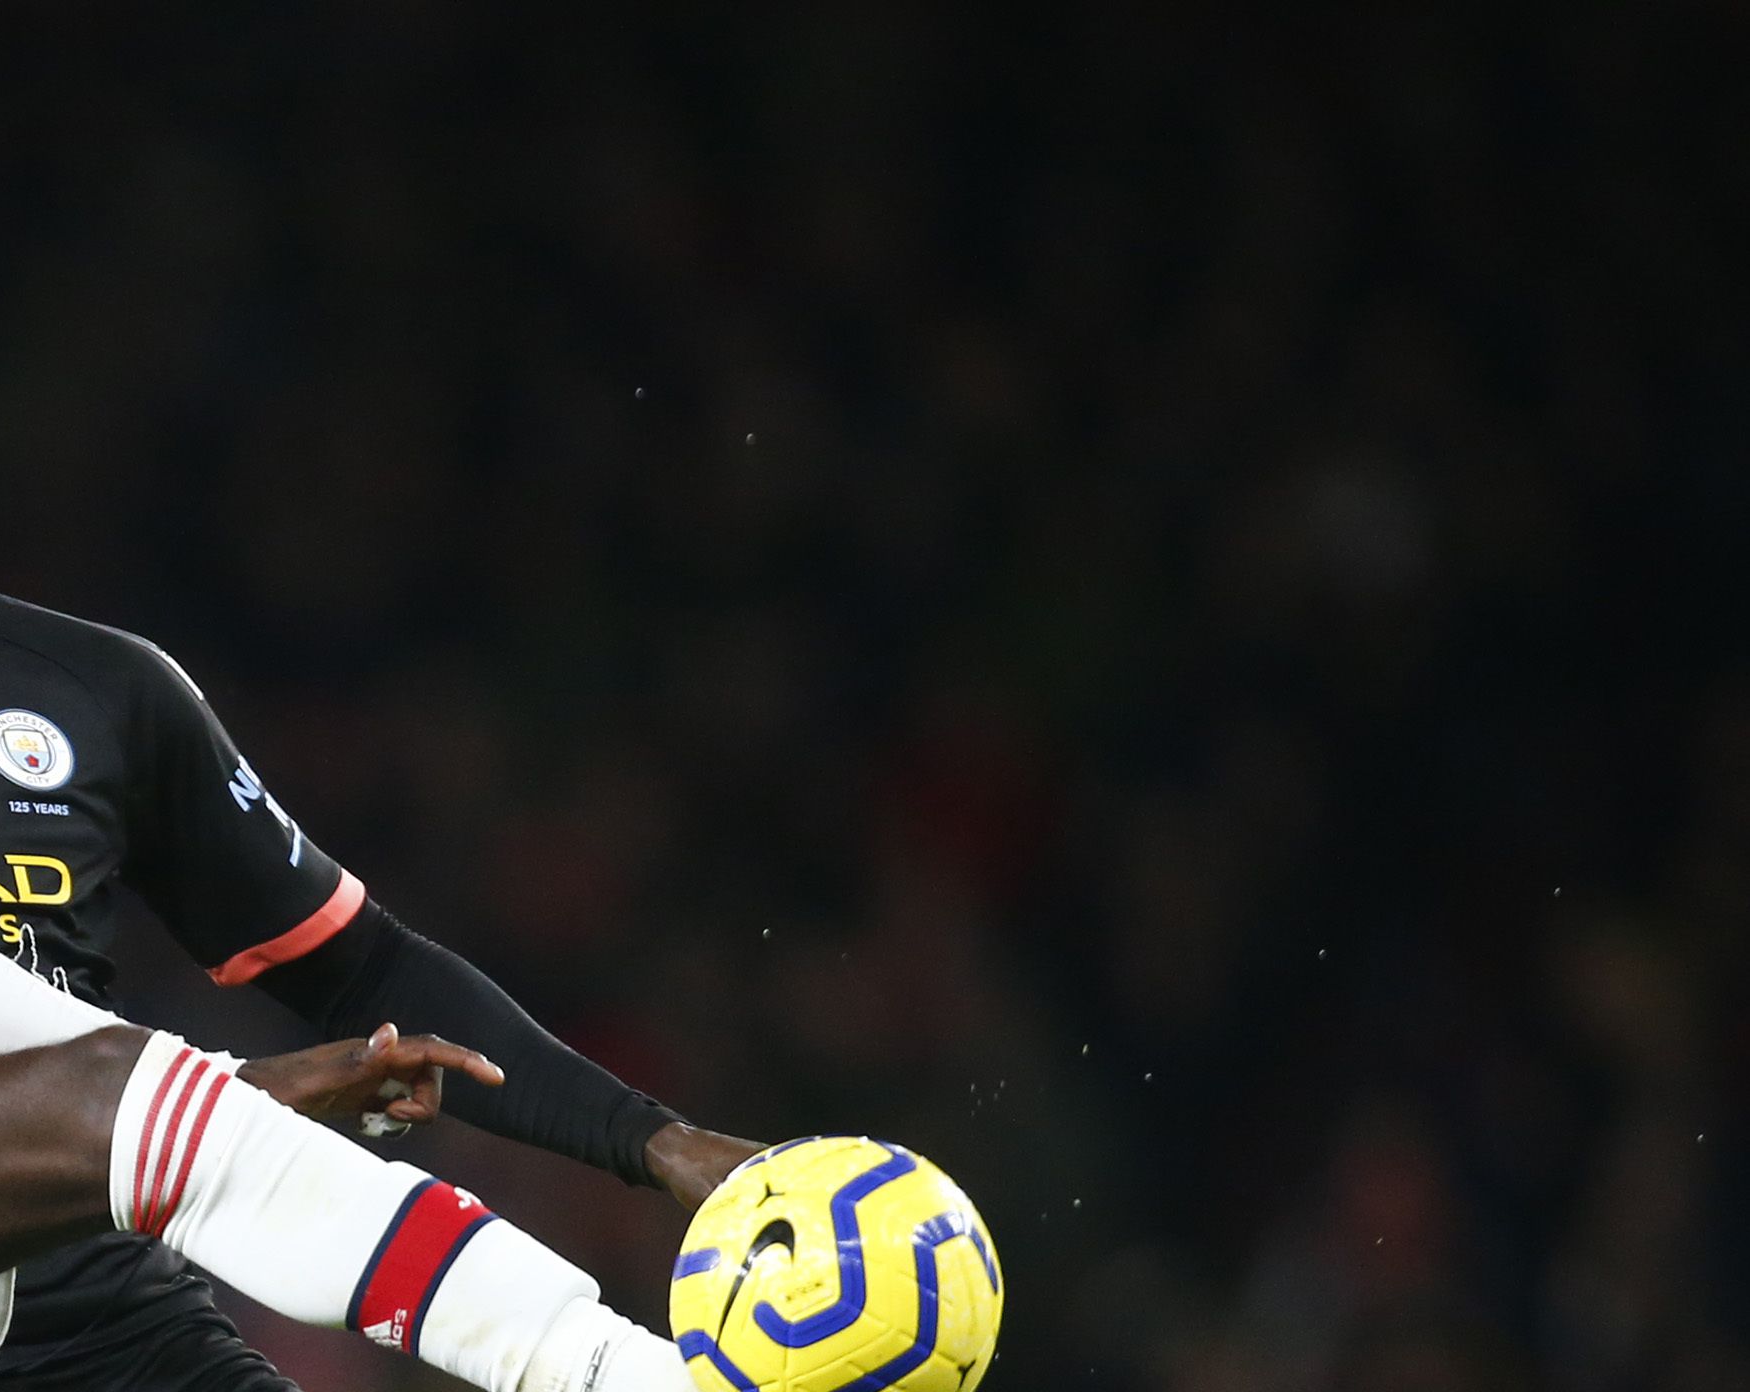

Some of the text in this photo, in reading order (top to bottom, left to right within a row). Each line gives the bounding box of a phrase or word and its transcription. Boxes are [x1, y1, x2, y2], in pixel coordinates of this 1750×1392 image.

[26, 776, 50, 785] CITY
[8, 801, 70, 816] 125 YEARS
